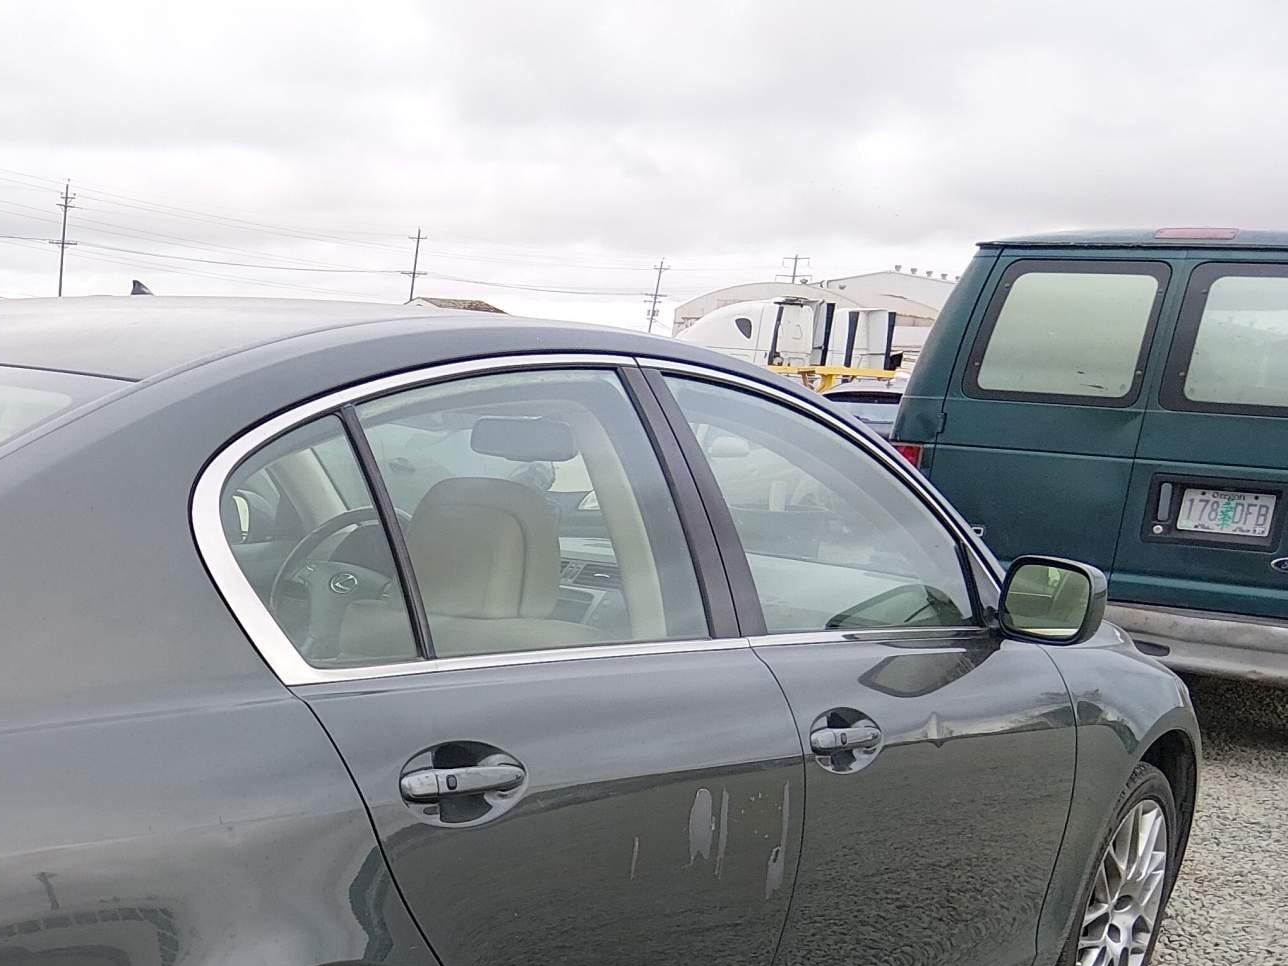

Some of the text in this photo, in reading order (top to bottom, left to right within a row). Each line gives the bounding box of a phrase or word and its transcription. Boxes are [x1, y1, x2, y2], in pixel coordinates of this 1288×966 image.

[1212, 491, 1246, 502] Oregon
[1187, 497, 1270, 527] 178 DFB
